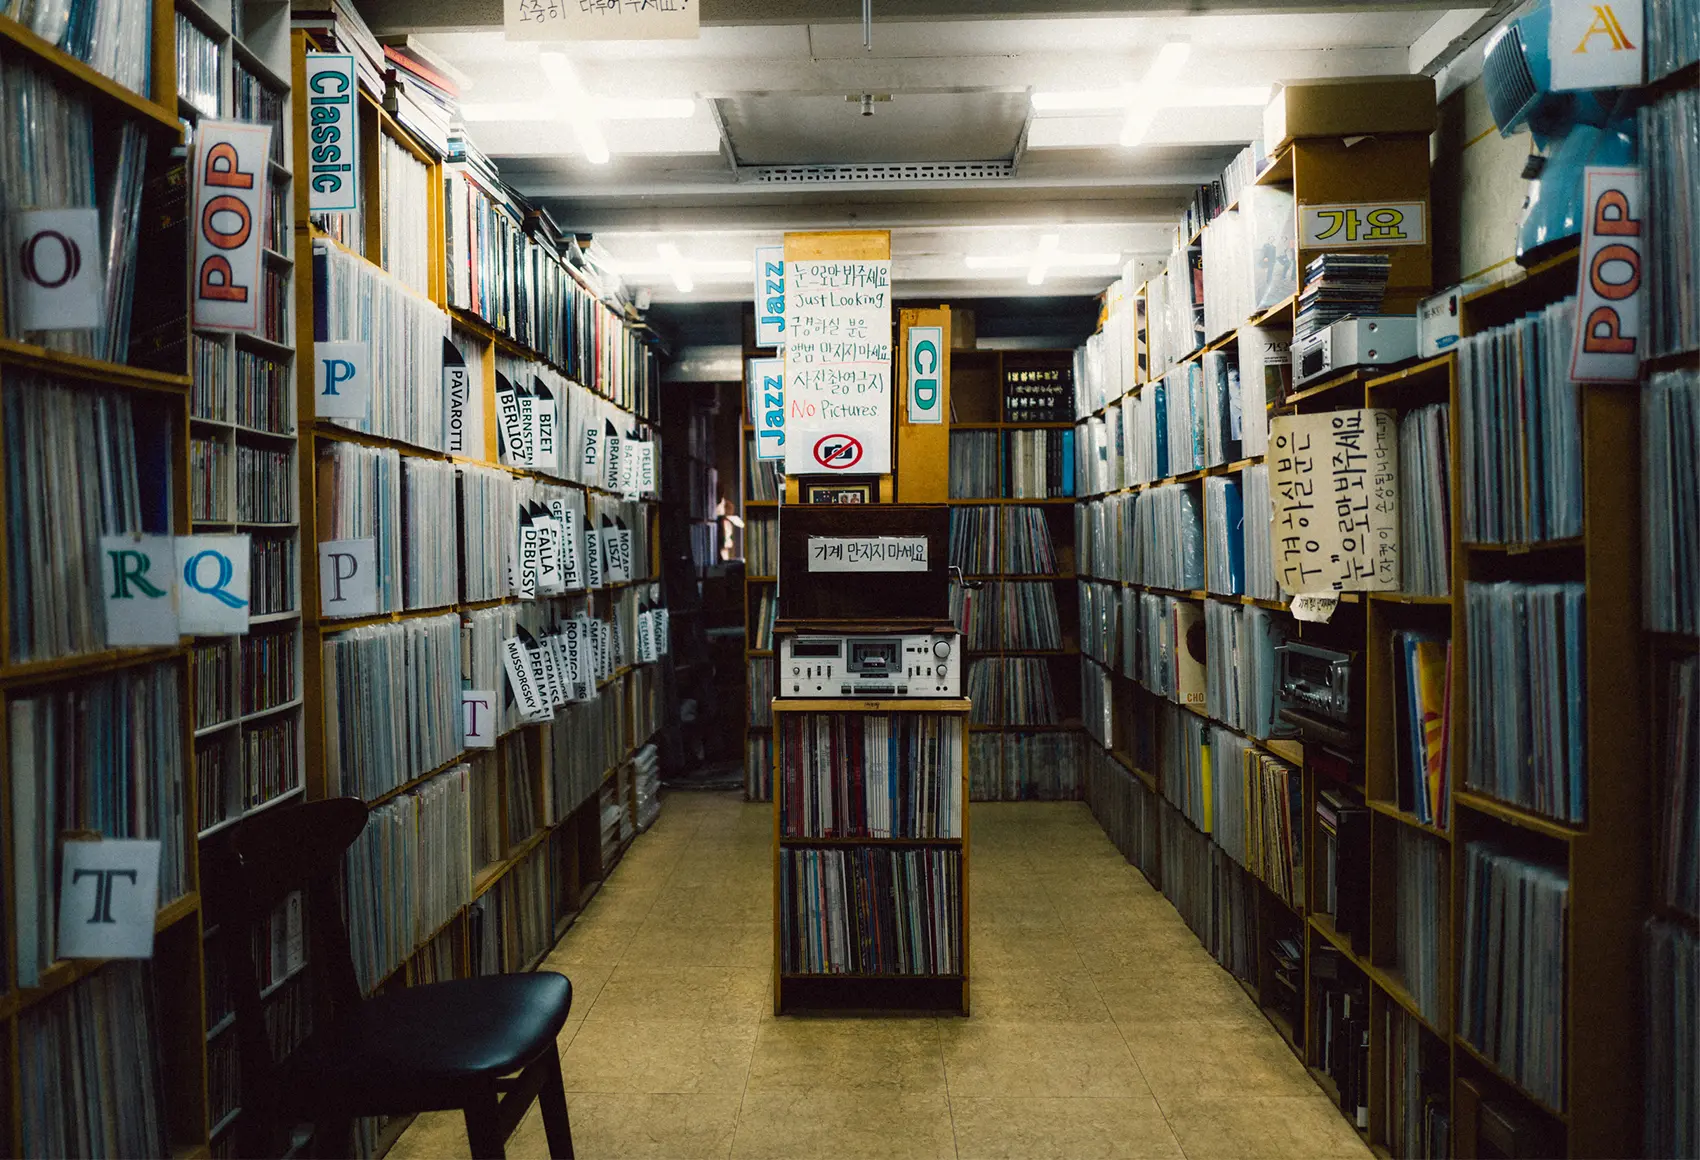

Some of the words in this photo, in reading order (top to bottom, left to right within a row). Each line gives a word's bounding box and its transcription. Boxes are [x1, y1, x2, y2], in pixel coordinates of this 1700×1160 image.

[1571, 4, 1637, 54] A
[309, 70, 351, 194] Classic
[199, 141, 254, 303] POP
[1315, 208, 1407, 241] 가요
[20, 229, 81, 288] O
[1583, 188, 1641, 354] POP
[761, 261, 785, 333] Jazz
[794, 292, 827, 308] Just
[791, 317, 840, 338] 구경하실
[846, 318, 868, 338] 분은
[791, 342, 815, 363] 앨범
[322, 358, 356, 396] P
[914, 339, 937, 411] CD
[450, 370, 464, 452] PAVAROTTI
[500, 394, 527, 461] BERLIOZ
[522, 399, 533, 466] BERNSTEIN
[540, 413, 553, 454] BIZET
[760, 374, 785, 446] Jazz
[792, 399, 816, 418] No
[585, 429, 598, 465] BACH
[607, 438, 620, 488] BRAHMS
[642, 447, 652, 486] DELIUS
[107, 549, 168, 599] R
[521, 530, 537, 597] DEBUSSY
[538, 527, 554, 575] FALLA
[587, 533, 599, 586] KARAJAN
[608, 538, 622, 570] LISZT
[814, 543, 843, 561] 기계
[847, 542, 885, 562] 만지지
[888, 542, 927, 562] 마세요
[184, 549, 248, 609] Q
[328, 553, 358, 602] P
[567, 621, 578, 681] RODRIGO
[640, 617, 651, 660] TELEMANN
[654, 611, 662, 653] WAGNER
[507, 642, 537, 709] MUSSORGSKY
[461, 700, 489, 737] T
[72, 868, 137, 924] T
